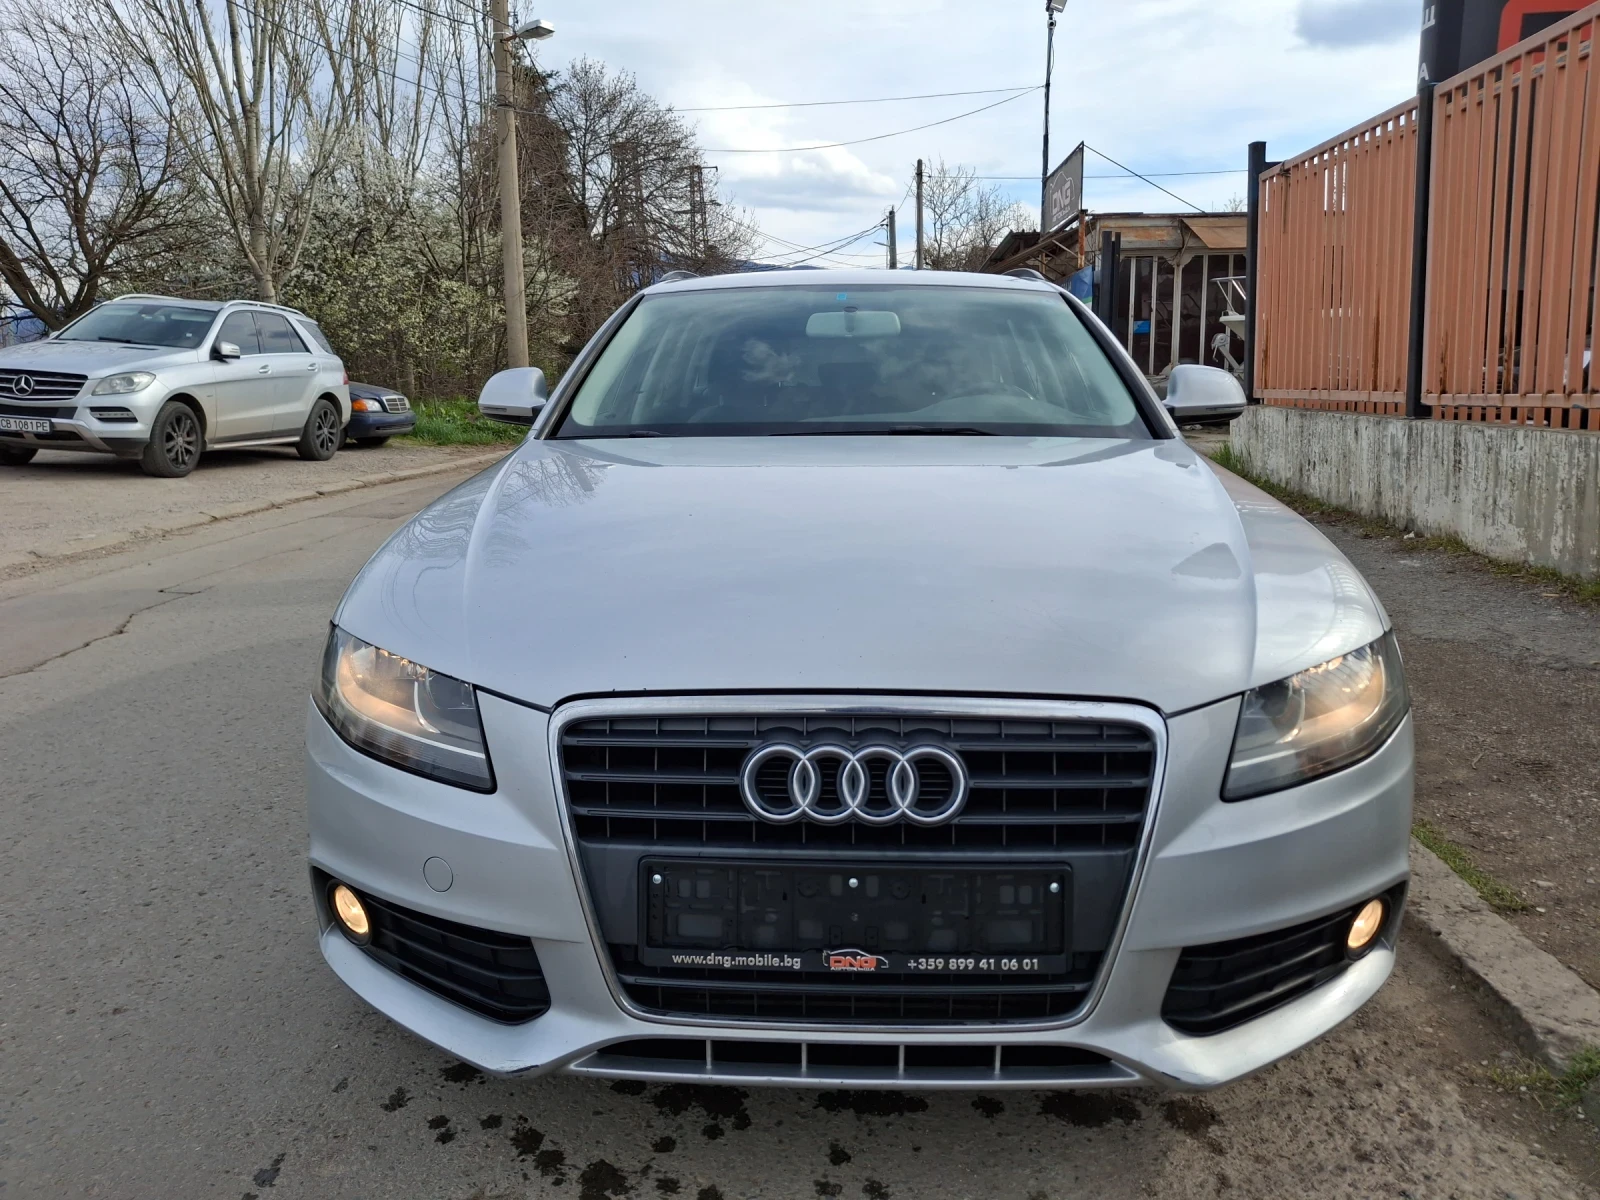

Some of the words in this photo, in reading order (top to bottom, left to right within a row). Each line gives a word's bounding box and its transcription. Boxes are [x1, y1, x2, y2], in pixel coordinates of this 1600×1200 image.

[14, 420, 34, 431] 1081
[672, 952, 801, 969] www.dng.mobile.bg
[907, 958, 945, 970] +359
[948, 958, 975, 970] 899
[979, 958, 995, 970] 41
[1001, 958, 1019, 970] 06
[1022, 958, 1039, 970] 01
